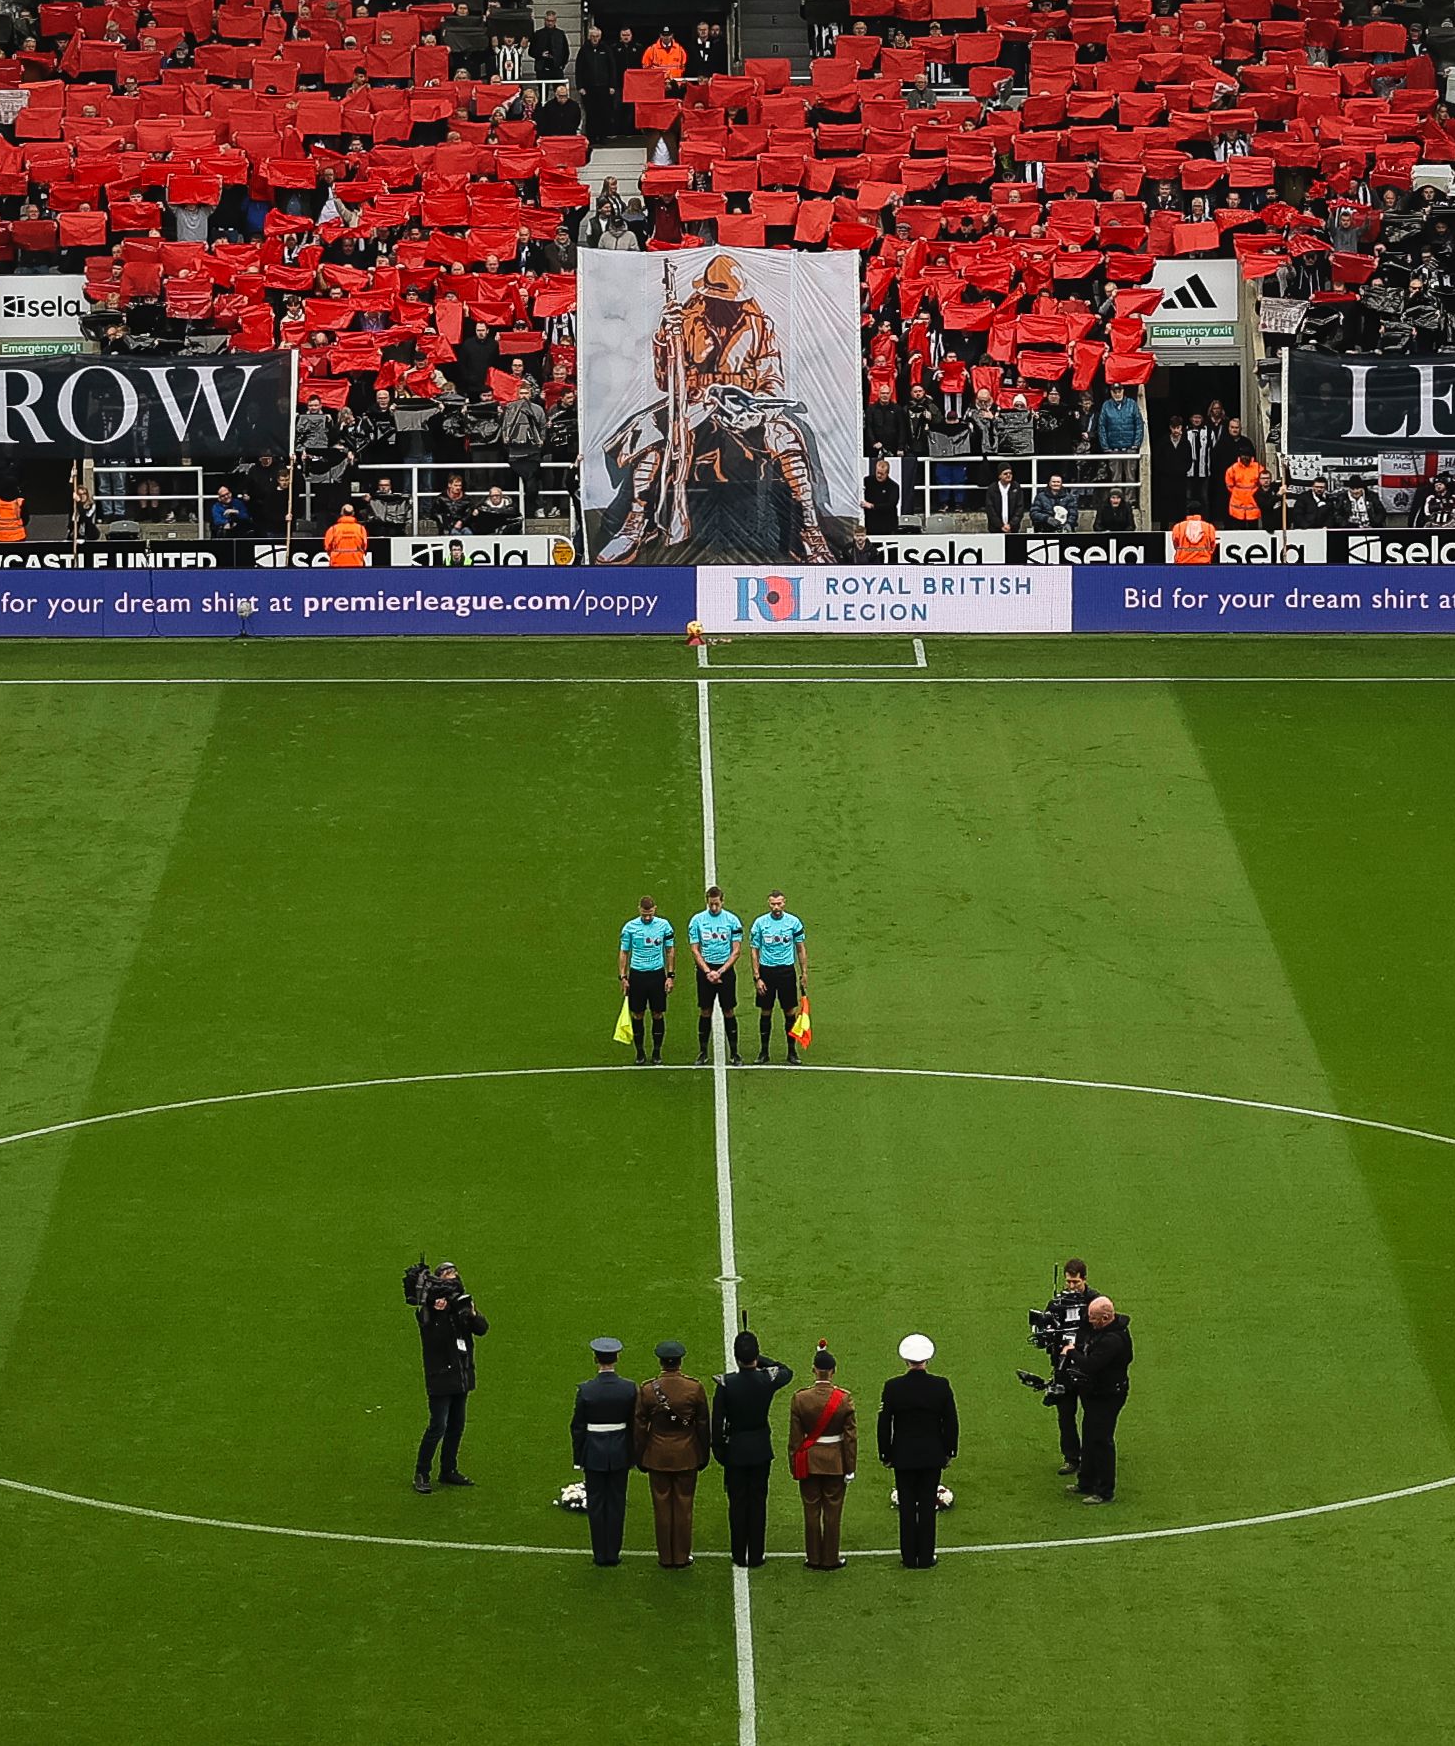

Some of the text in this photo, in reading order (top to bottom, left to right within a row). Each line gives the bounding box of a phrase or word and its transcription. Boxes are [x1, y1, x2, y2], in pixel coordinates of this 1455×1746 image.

[28, 296, 85, 317] sela
[1152, 326, 1232, 338] Emergency exit
[1, 343, 81, 354] Emergency exit
[905, 539, 983, 564] sela
[1063, 539, 1145, 564] sela
[1226, 538, 1305, 563] sela
[826, 577, 1032, 596] ROYAL BRITISH
[1, 591, 38, 613] for
[47, 597, 104, 621] your
[115, 590, 191, 613] dream
[270, 596, 293, 612] at
[303, 589, 658, 618] premierleague.com/poppy
[826, 603, 928, 622] LEGION
[1125, 587, 1162, 610] Bid
[1172, 587, 1210, 610] for
[1218, 593, 1276, 617] your
[1285, 587, 1361, 609] dream
[1371, 587, 1427, 609] shirt
